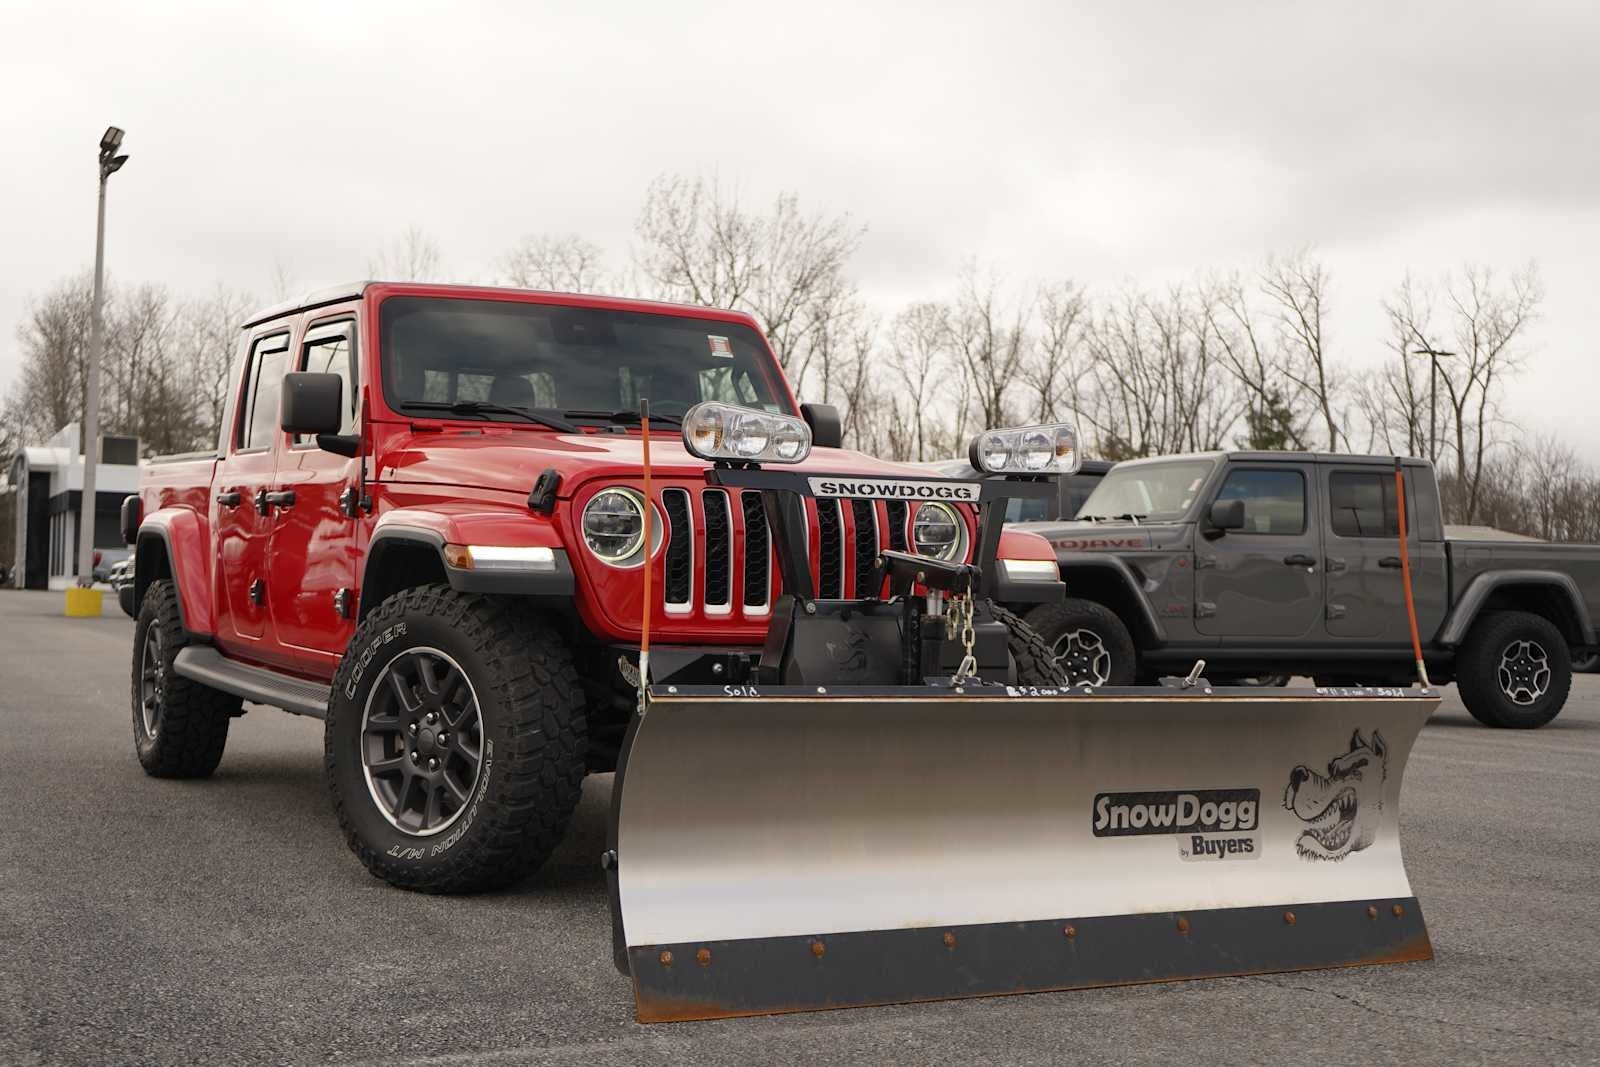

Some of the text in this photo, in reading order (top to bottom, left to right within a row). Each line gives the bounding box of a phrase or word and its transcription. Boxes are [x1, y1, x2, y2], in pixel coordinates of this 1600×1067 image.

[819, 482, 972, 499] SNOWDOGG
[345, 622, 407, 700] COOPER
[386, 739, 494, 860] EVOLUTION M/T
[1095, 794, 1256, 831] SnowDogg
[1180, 836, 1254, 859] by Buyers
